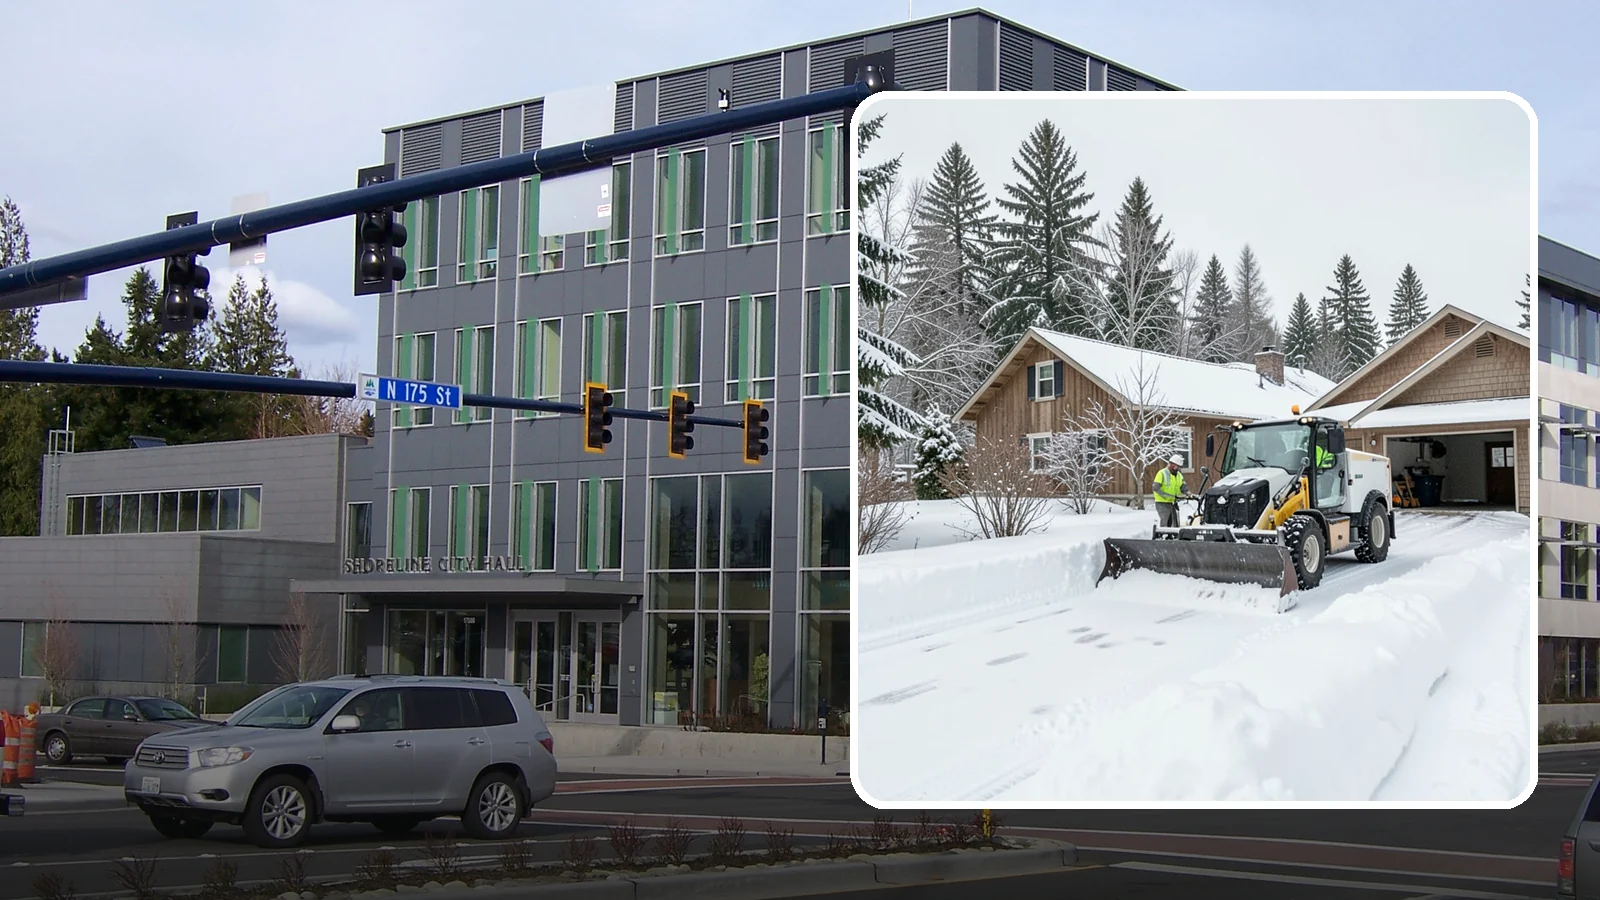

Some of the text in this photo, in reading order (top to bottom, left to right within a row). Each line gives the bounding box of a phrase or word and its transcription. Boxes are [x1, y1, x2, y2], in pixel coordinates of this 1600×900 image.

[387, 380, 451, 406] N 175 St
[343, 555, 526, 575] SHORELINE CITY HALL
